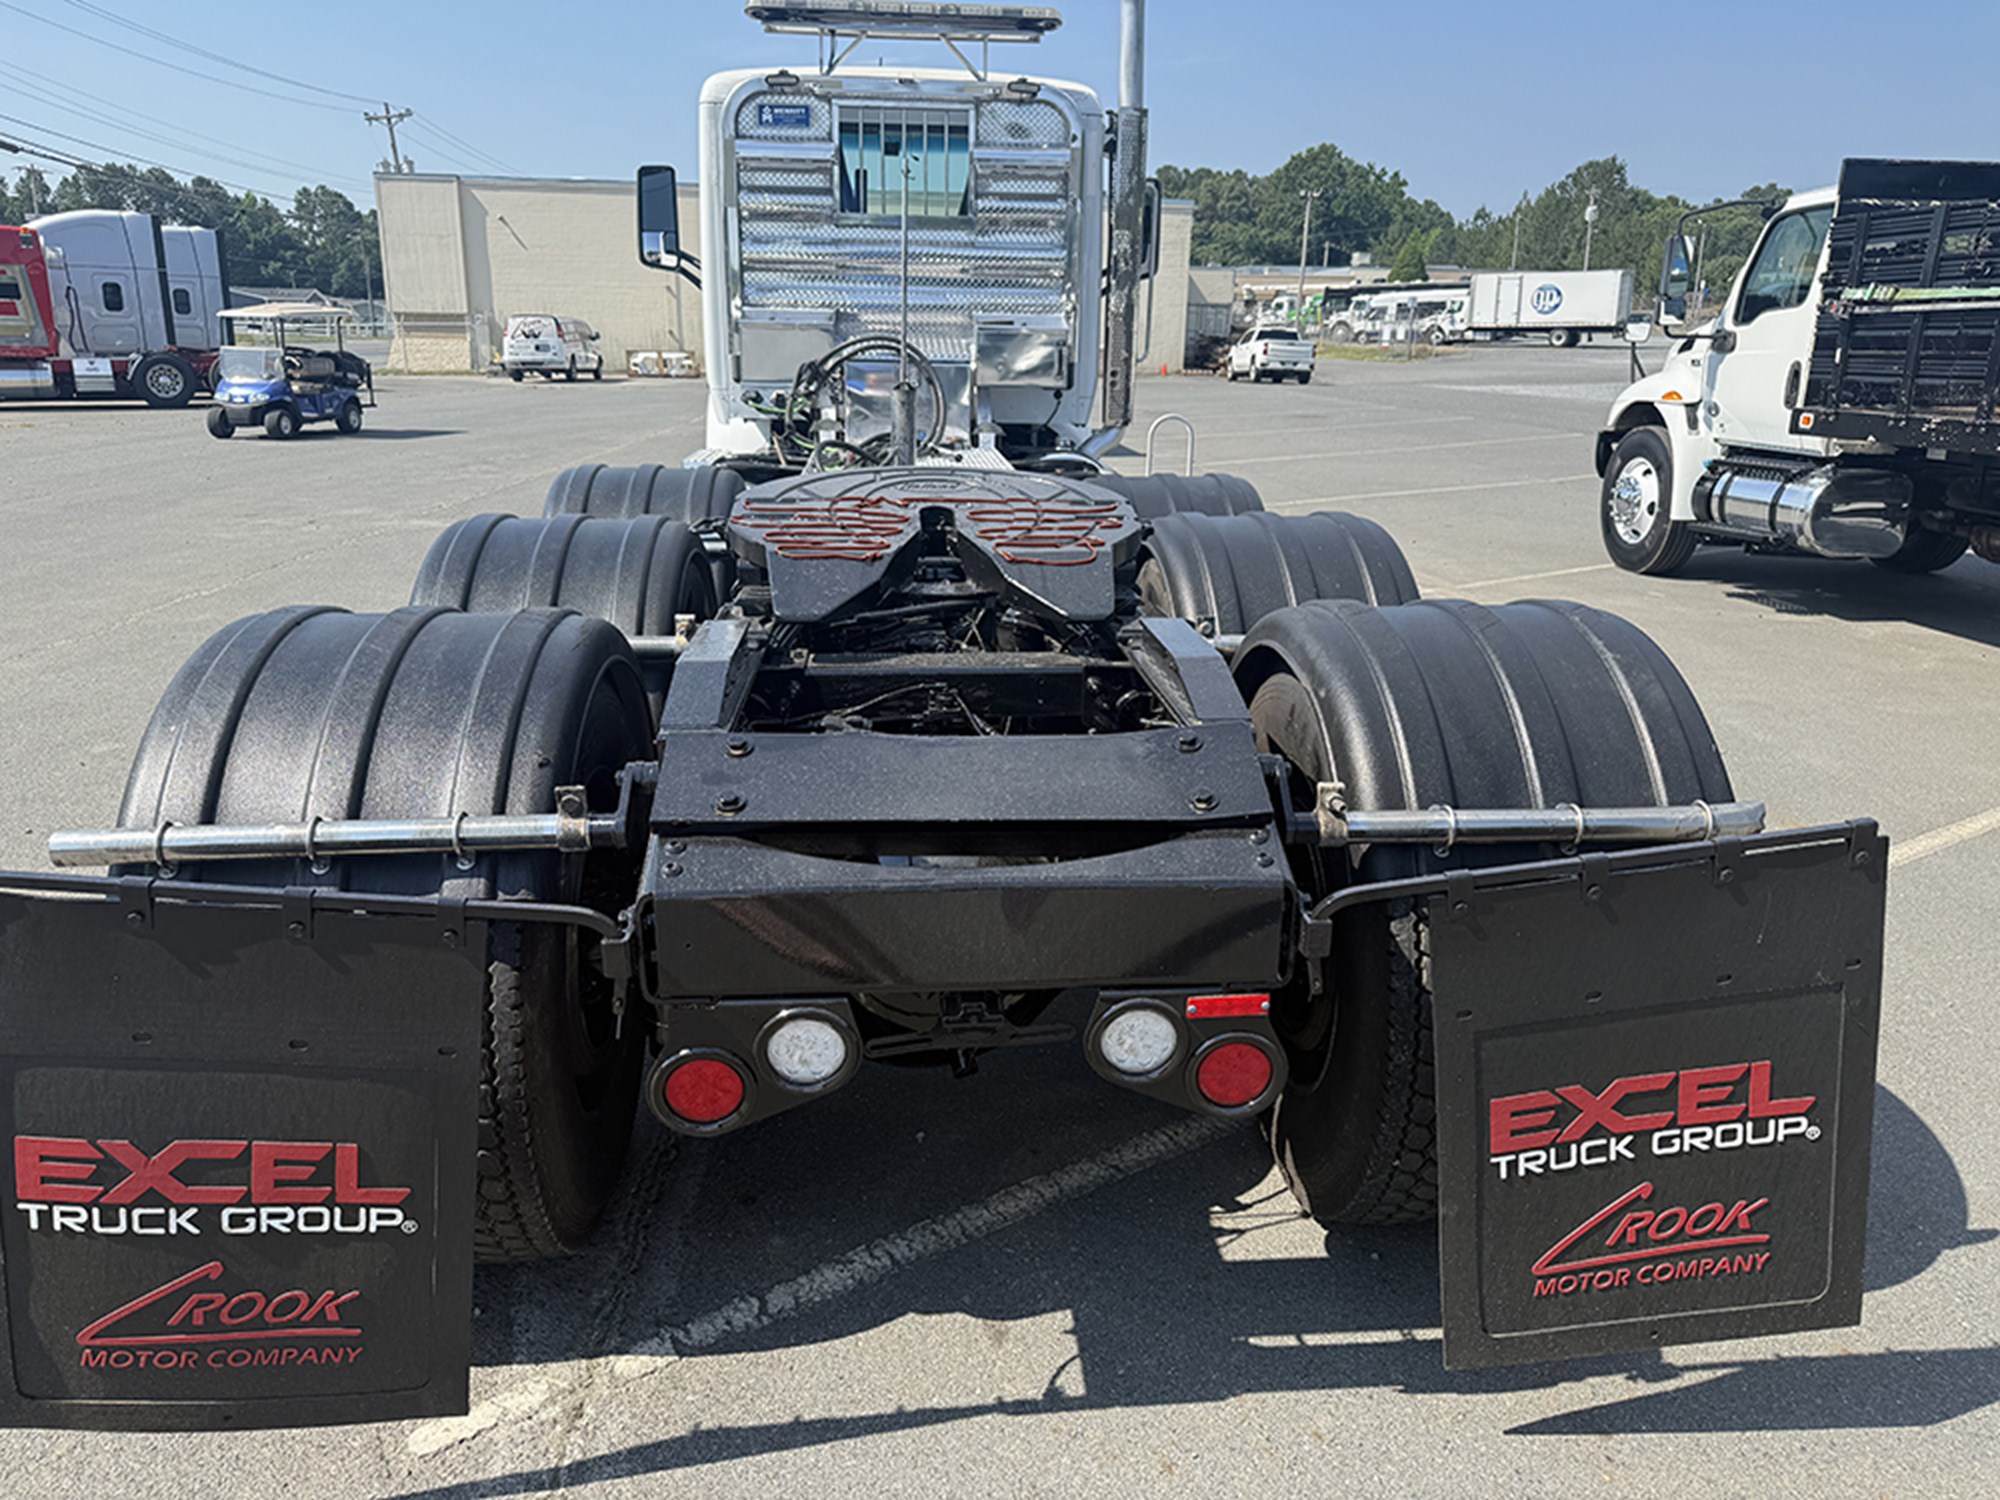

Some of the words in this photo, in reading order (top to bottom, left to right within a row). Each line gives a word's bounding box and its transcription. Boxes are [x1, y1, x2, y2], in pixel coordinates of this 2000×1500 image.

[1489, 1060, 1816, 1154] EXCEL
[14, 1135, 411, 1204] EXCEL
[1490, 1134, 1635, 1180] TRUCK
[16, 1202, 200, 1235] TRUCK
[1533, 1268, 1632, 1297] MOTOR
[1636, 1252, 1771, 1284] COMPANY
[80, 1347, 198, 1369] MOTOR
[206, 1346, 363, 1369] COMPANY
